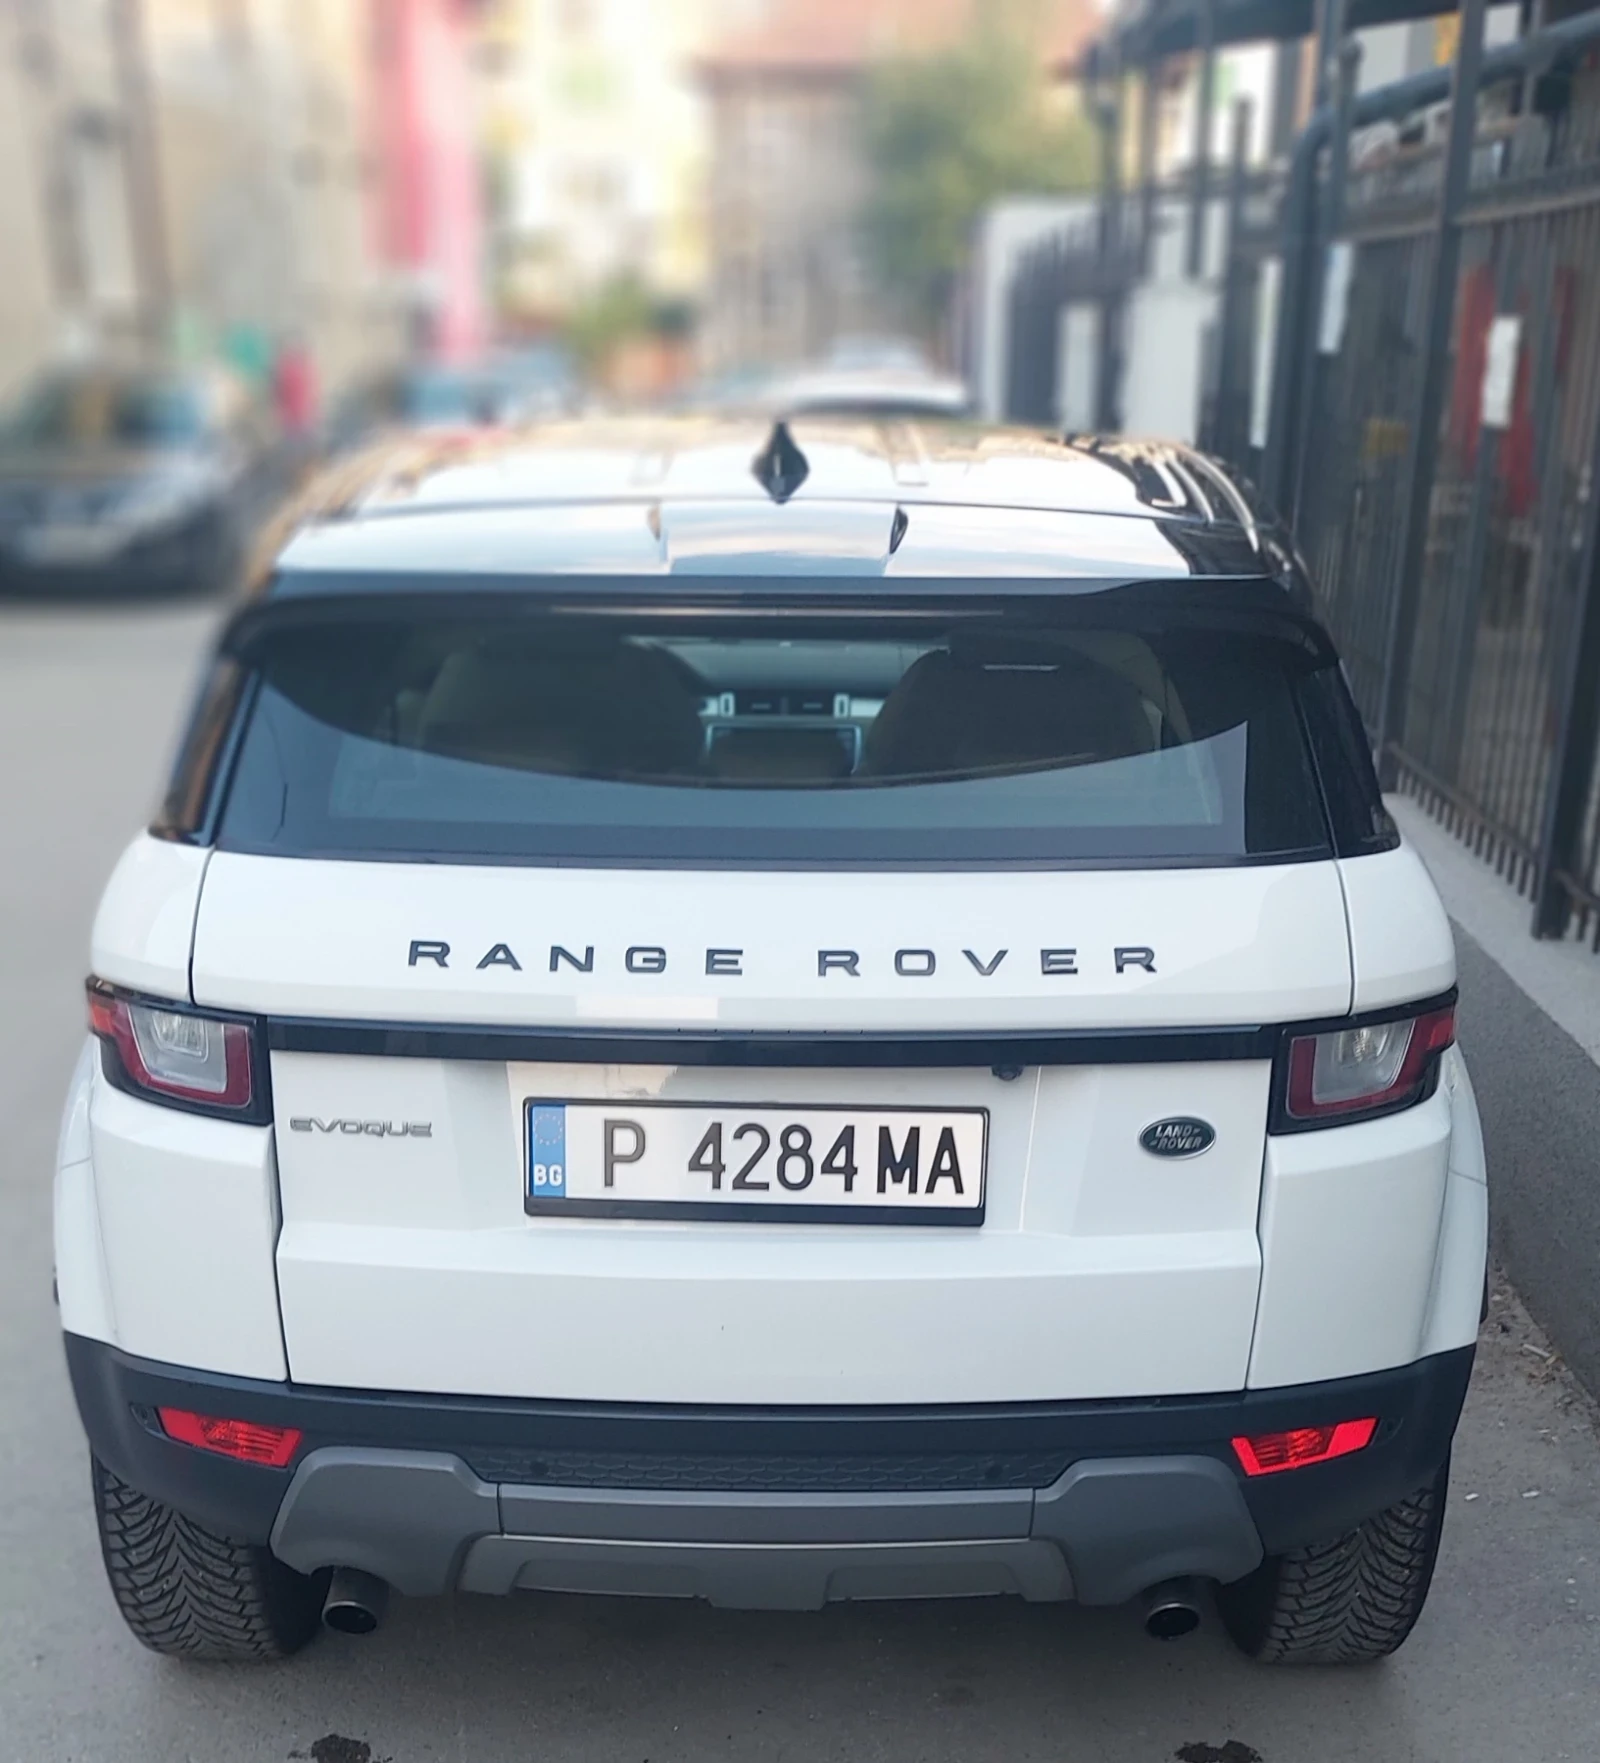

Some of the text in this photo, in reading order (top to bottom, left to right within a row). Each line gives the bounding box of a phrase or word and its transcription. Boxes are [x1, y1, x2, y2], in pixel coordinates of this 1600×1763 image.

[407, 939, 1158, 977] RANGE ROVER
[289, 1115, 432, 1138] EVOQUE
[604, 1119, 964, 1194] P 4284 MA
[533, 1163, 563, 1187] BG
